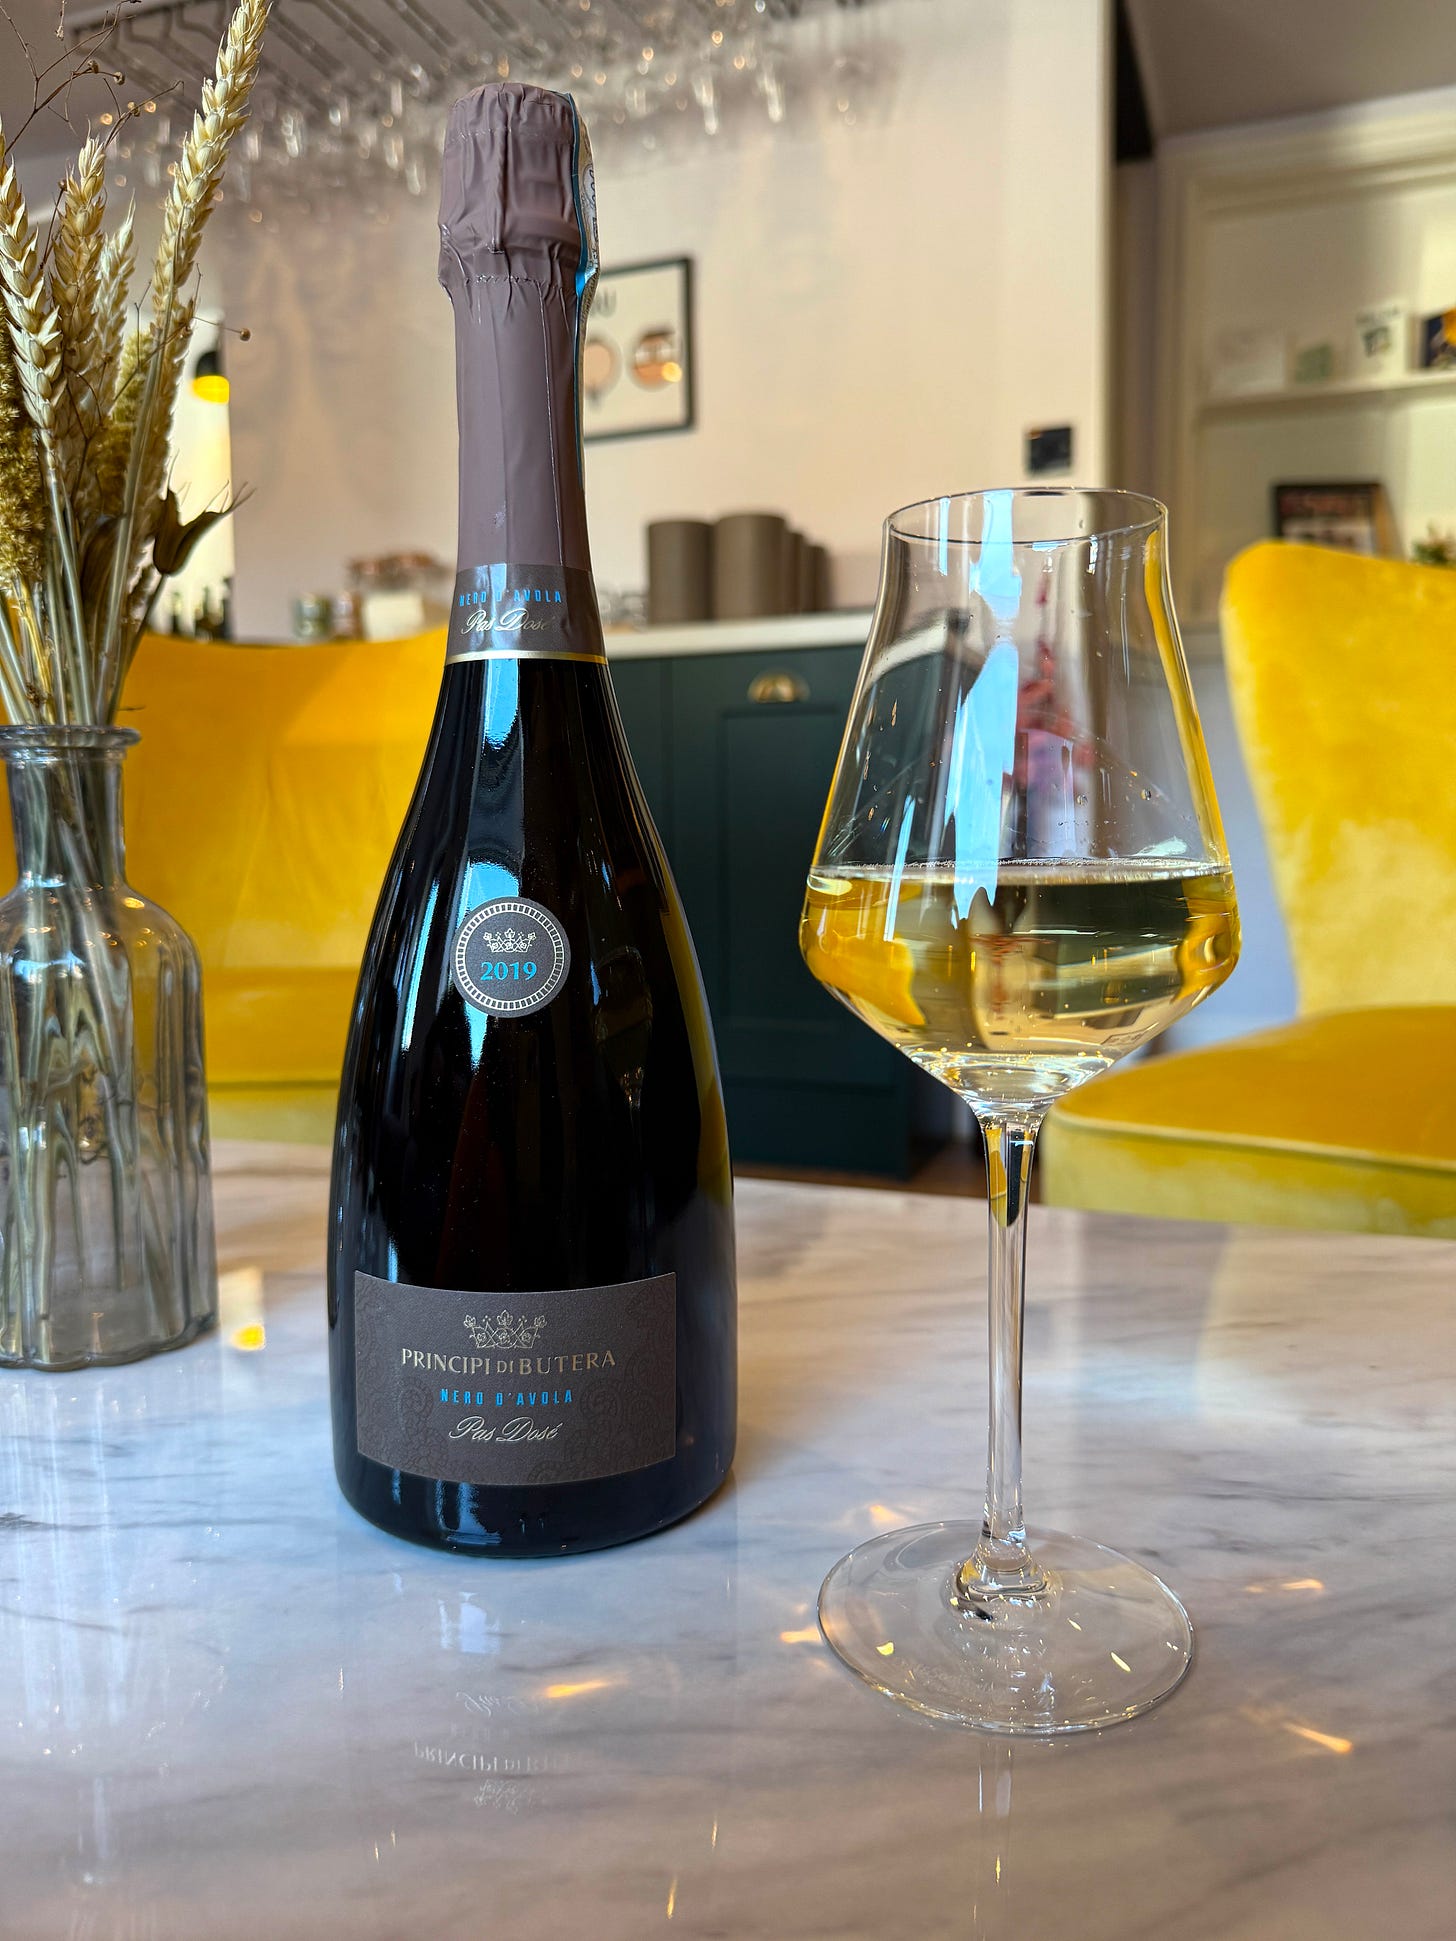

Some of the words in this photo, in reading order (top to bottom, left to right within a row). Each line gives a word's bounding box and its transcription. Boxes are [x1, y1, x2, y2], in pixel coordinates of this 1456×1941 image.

[459, 591, 487, 607] NERO
[495, 589, 562, 604] D'AVOLA
[460, 609, 495, 635] Pas
[480, 961, 538, 981] 2019
[401, 1348, 491, 1375] PRINCIPI
[519, 1350, 617, 1376] BUTERA
[440, 1388, 484, 1406] NERO
[495, 1389, 573, 1407] D'AVOLA
[449, 1415, 498, 1441] Pas
[495, 1416, 564, 1442] Dosé
